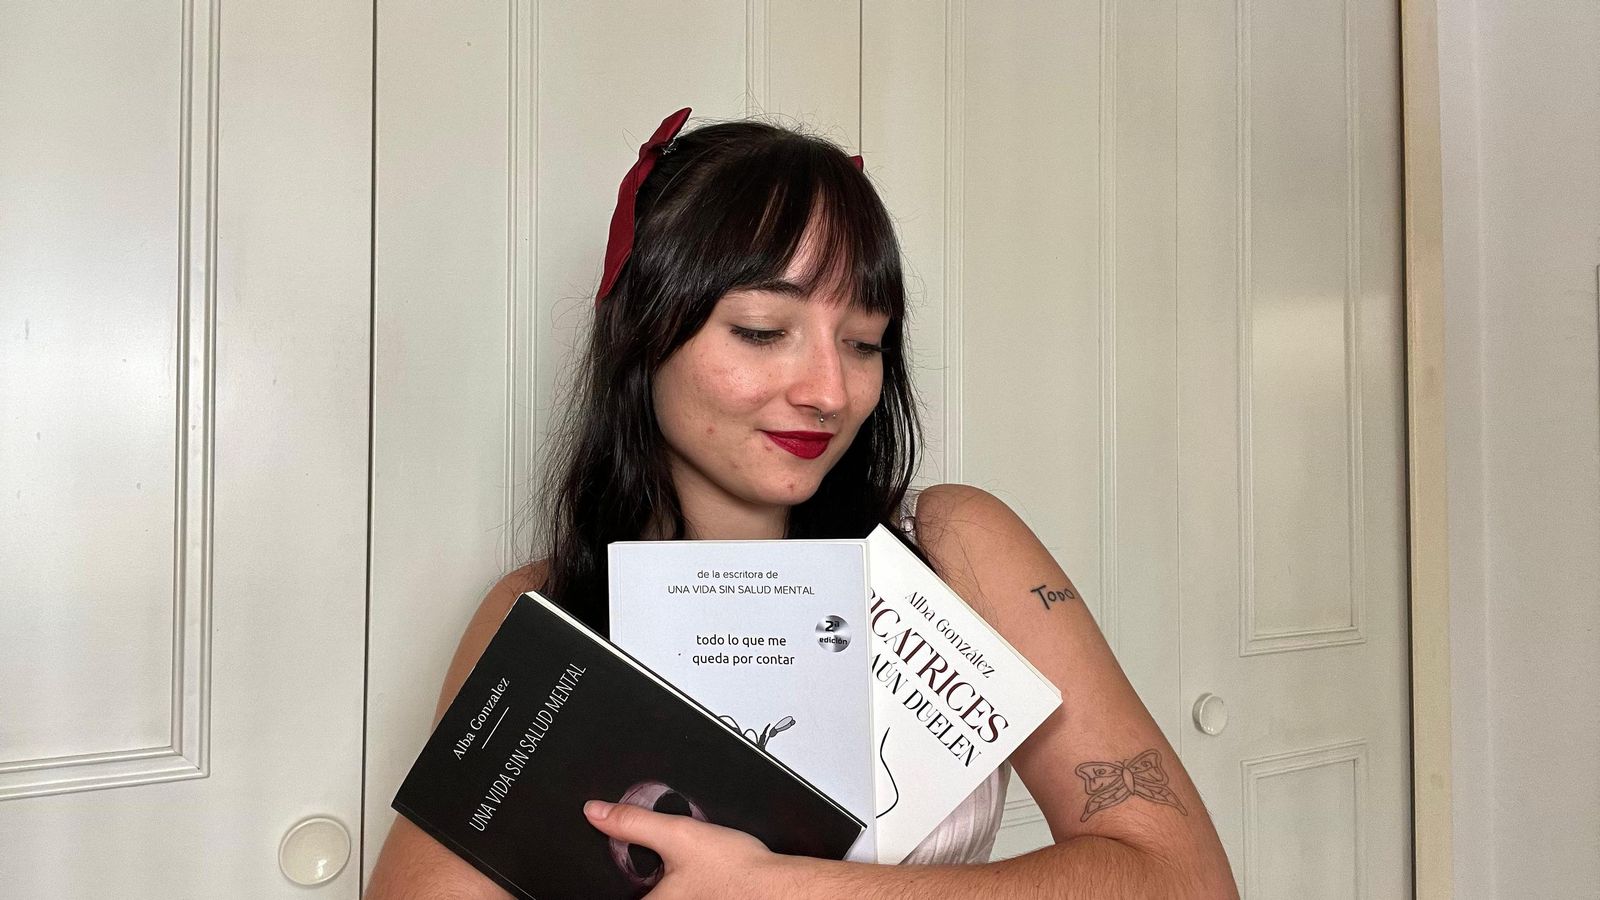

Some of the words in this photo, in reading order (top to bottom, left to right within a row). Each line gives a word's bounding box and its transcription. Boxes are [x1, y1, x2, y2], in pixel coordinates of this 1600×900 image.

[667, 585, 690, 594] UNA
[692, 585, 717, 594] VIDA
[718, 585, 735, 595] SIN
[737, 585, 772, 595] SALUD
[774, 585, 815, 596] MENTAL
[697, 569, 710, 579] de
[712, 569, 721, 579] la
[723, 569, 763, 579] escritora
[766, 569, 779, 580] de
[696, 634, 725, 646] todo
[727, 634, 739, 646] lo
[742, 637, 766, 648] que
[768, 637, 787, 646] me
[819, 636, 848, 645] edición
[904, 591, 936, 622] Alba
[936, 617, 995, 679] González
[692, 653, 730, 666] queda
[732, 655, 754, 666] por
[756, 654, 795, 665] contar
[870, 586, 1009, 744] ICATRICES
[453, 734, 476, 760] Alba
[470, 677, 510, 731] Gonzalez
[902, 689, 982, 768] DUELEN
[469, 803, 497, 832] UNA
[485, 773, 516, 804] VIDA
[505, 748, 530, 776] SIN
[519, 709, 554, 753] SALUD
[544, 663, 587, 713] MENTAL
